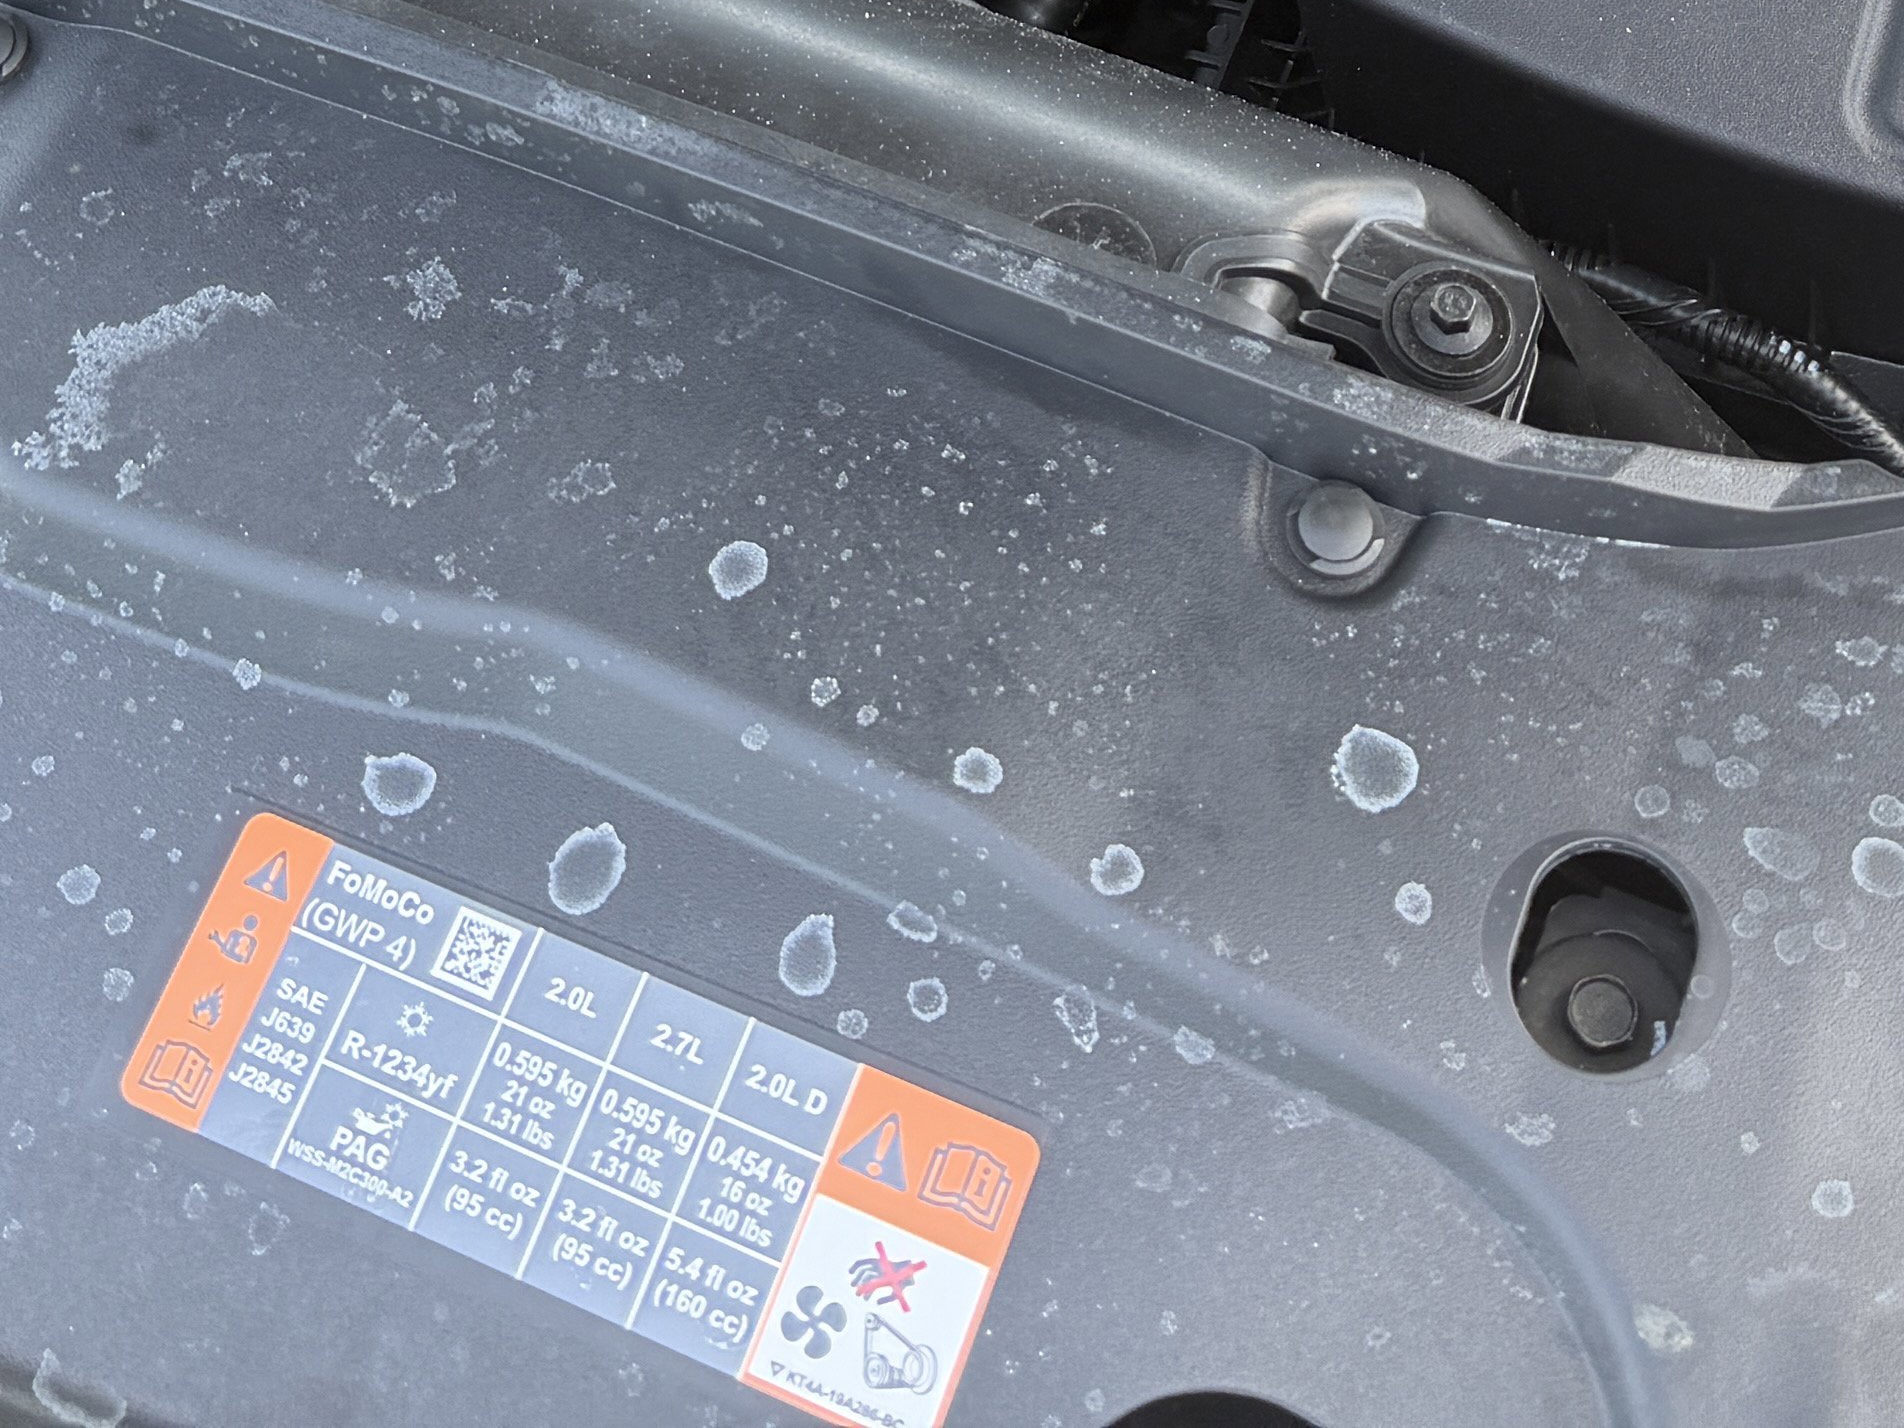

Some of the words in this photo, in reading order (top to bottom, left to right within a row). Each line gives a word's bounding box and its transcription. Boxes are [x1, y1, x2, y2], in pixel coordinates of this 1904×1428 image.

[326, 861, 435, 925] FoMoCo
[301, 897, 386, 948] (GWP
[385, 933, 416, 970] 4)
[276, 978, 329, 1014] SAE
[544, 977, 597, 1018] 2.0L
[260, 1008, 317, 1044] J639
[649, 1023, 706, 1065] 2.7L
[242, 1032, 310, 1076] J2842
[340, 1030, 460, 1101] R-1234yf
[493, 1041, 558, 1087] 0.595
[555, 1069, 589, 1108] kg
[228, 1062, 297, 1106] J2845
[500, 1080, 529, 1107] 21
[528, 1095, 557, 1120] oz
[745, 1063, 800, 1108] 2.0L
[804, 1089, 830, 1116] D
[483, 1101, 519, 1136] 1.31
[523, 1118, 556, 1151] lbs
[600, 1088, 664, 1135] 0.595
[663, 1115, 697, 1156] kg
[608, 1128, 637, 1155] 21
[636, 1143, 665, 1168] oz
[331, 1126, 392, 1171] PAG
[706, 1135, 773, 1184] 0.454
[772, 1163, 806, 1205] kg
[448, 1150, 485, 1185] 3.2
[489, 1165, 509, 1193] fl
[509, 1180, 542, 1209] oz
[590, 1150, 629, 1185] 1.31
[631, 1166, 665, 1200] lbs
[719, 1176, 747, 1204] 16
[745, 1191, 775, 1217] oz
[443, 1183, 483, 1221] (95
[482, 1201, 524, 1241] cc)
[557, 1198, 595, 1234] 3.2
[597, 1213, 618, 1242] fl
[618, 1228, 651, 1257] oz
[698, 1197, 737, 1233] 1.00
[739, 1214, 773, 1248] lbs
[552, 1232, 593, 1269] (95
[593, 1251, 635, 1291] cc)
[664, 1244, 702, 1280] 5.4
[704, 1261, 726, 1291] fl
[726, 1278, 761, 1307] oz
[652, 1278, 704, 1320] (160
[704, 1300, 749, 1342] cc)
